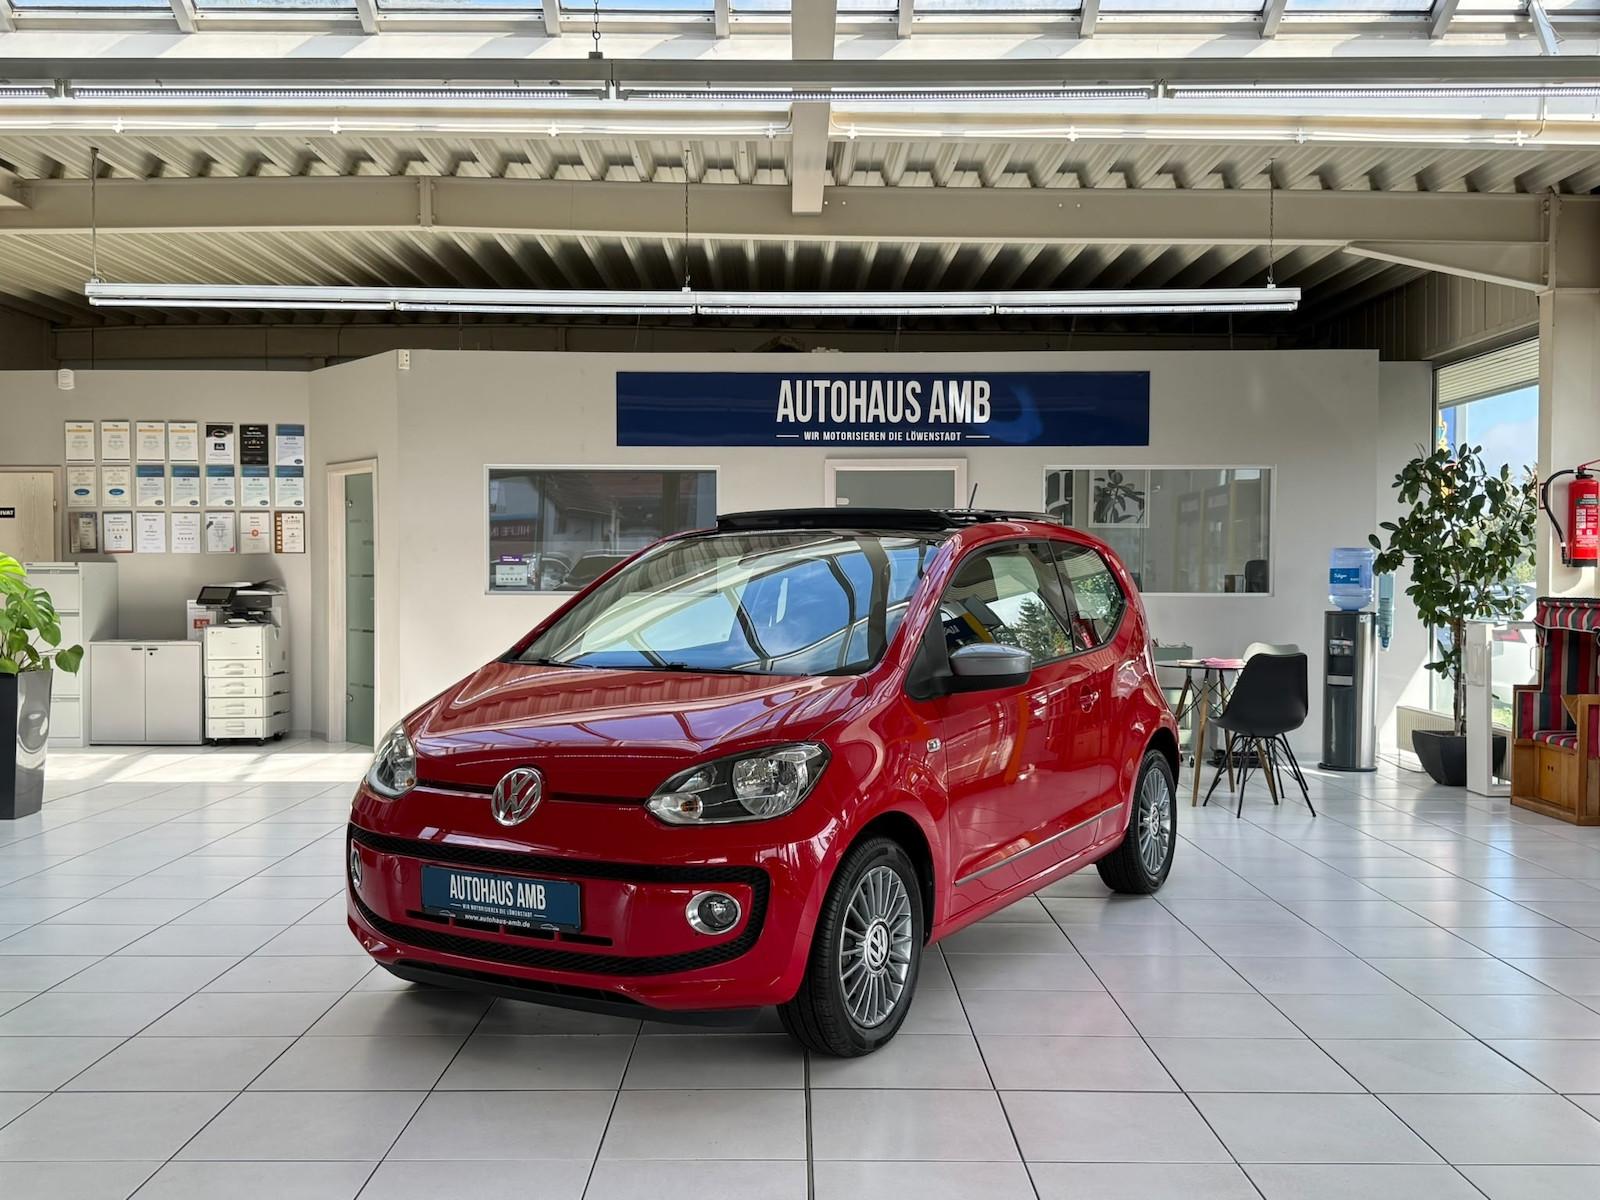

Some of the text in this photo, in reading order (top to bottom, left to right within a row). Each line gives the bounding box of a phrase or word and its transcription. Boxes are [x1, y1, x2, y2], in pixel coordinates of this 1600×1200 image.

[776, 379, 991, 424] AUTOHAUS AMB
[804, 431, 962, 441] WIR MOTORISIEREN DIE LÖWENSTADT
[450, 874, 547, 910] AUTOHAUS AMB
[464, 914, 531, 928] www.autohaus-amb.de
